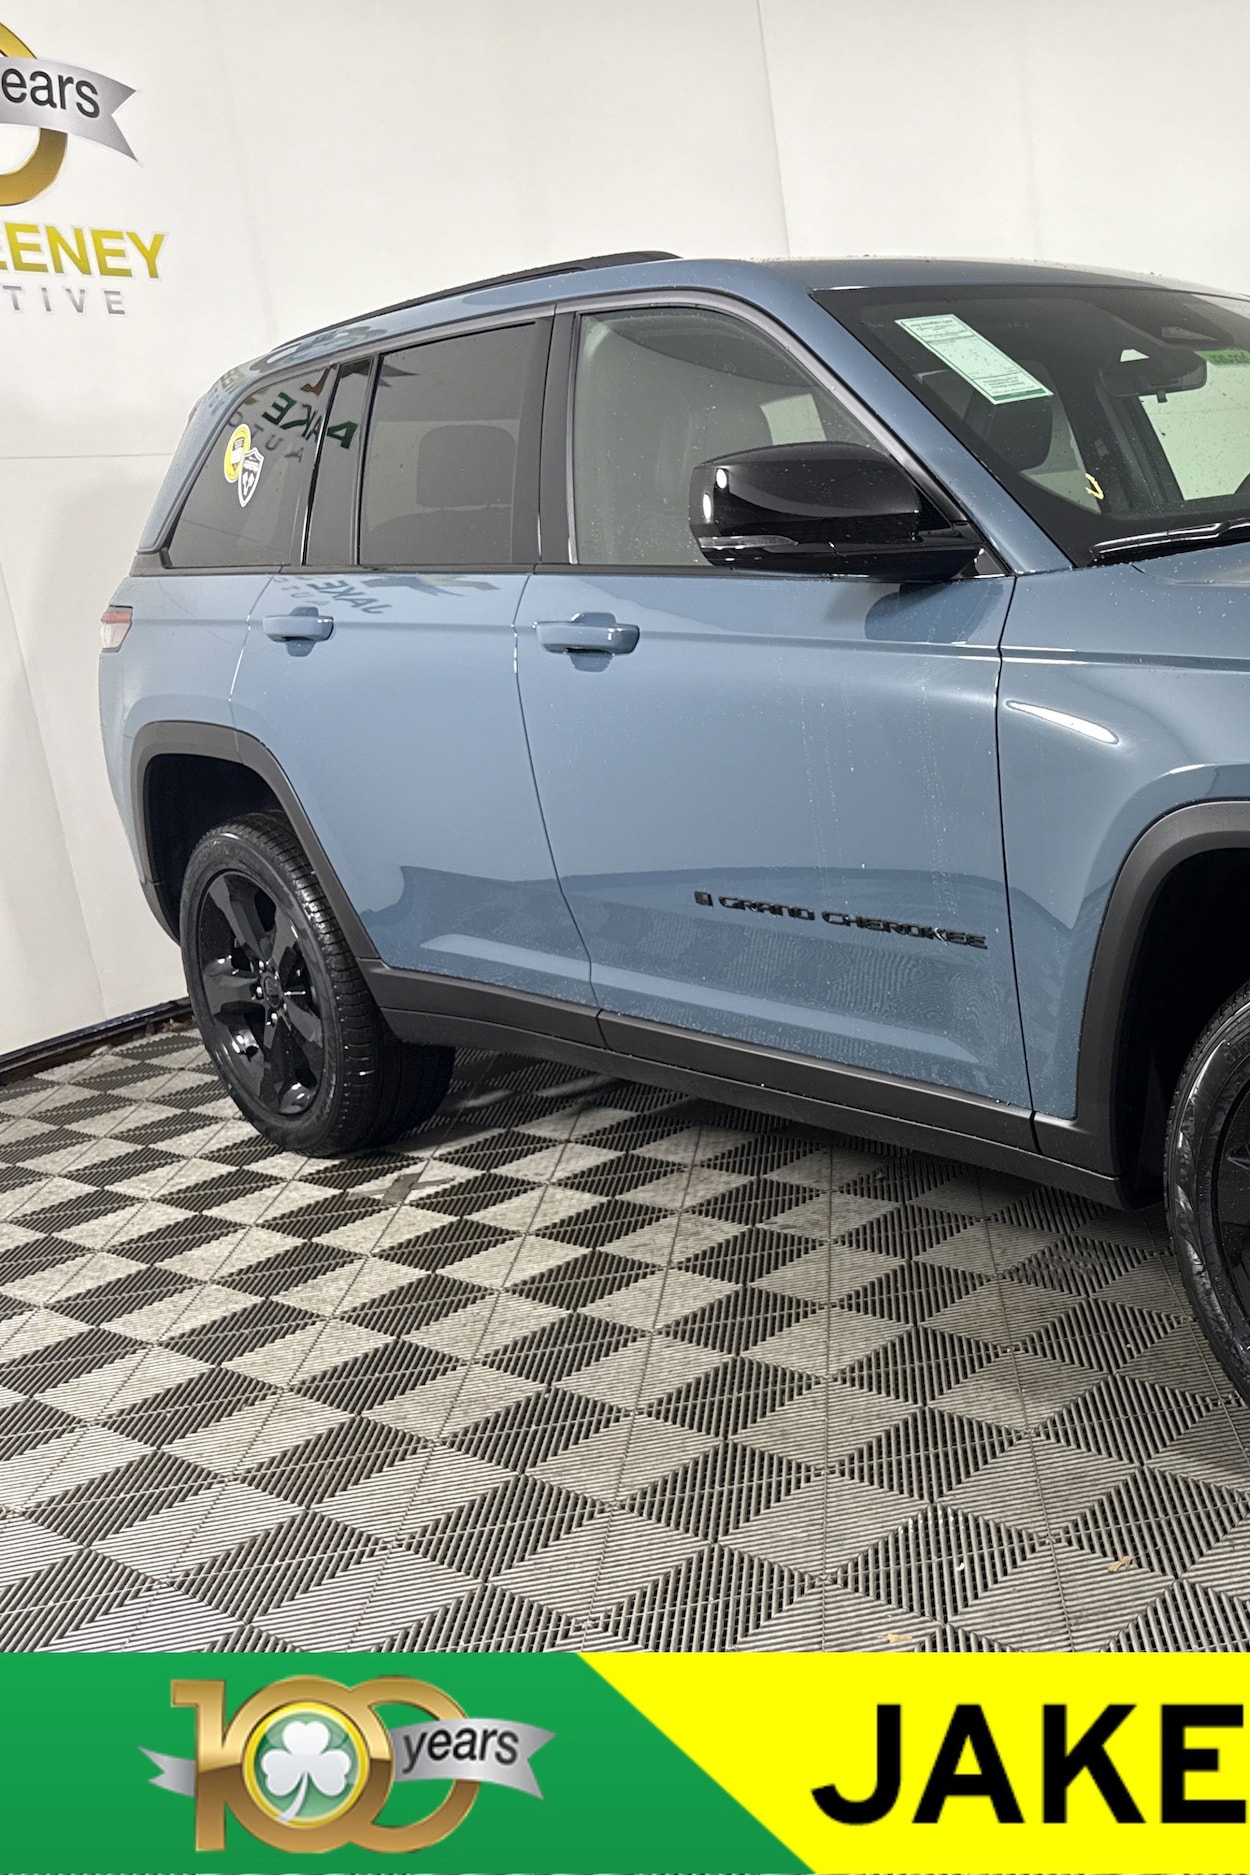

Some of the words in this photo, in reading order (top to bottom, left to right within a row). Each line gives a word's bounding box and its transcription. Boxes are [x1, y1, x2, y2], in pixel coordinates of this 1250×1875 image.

[0, 67, 101, 119] ears
[0, 222, 165, 279] ENEY
[718, 896, 815, 921] GRAND
[822, 911, 987, 950] CHEROKEE
